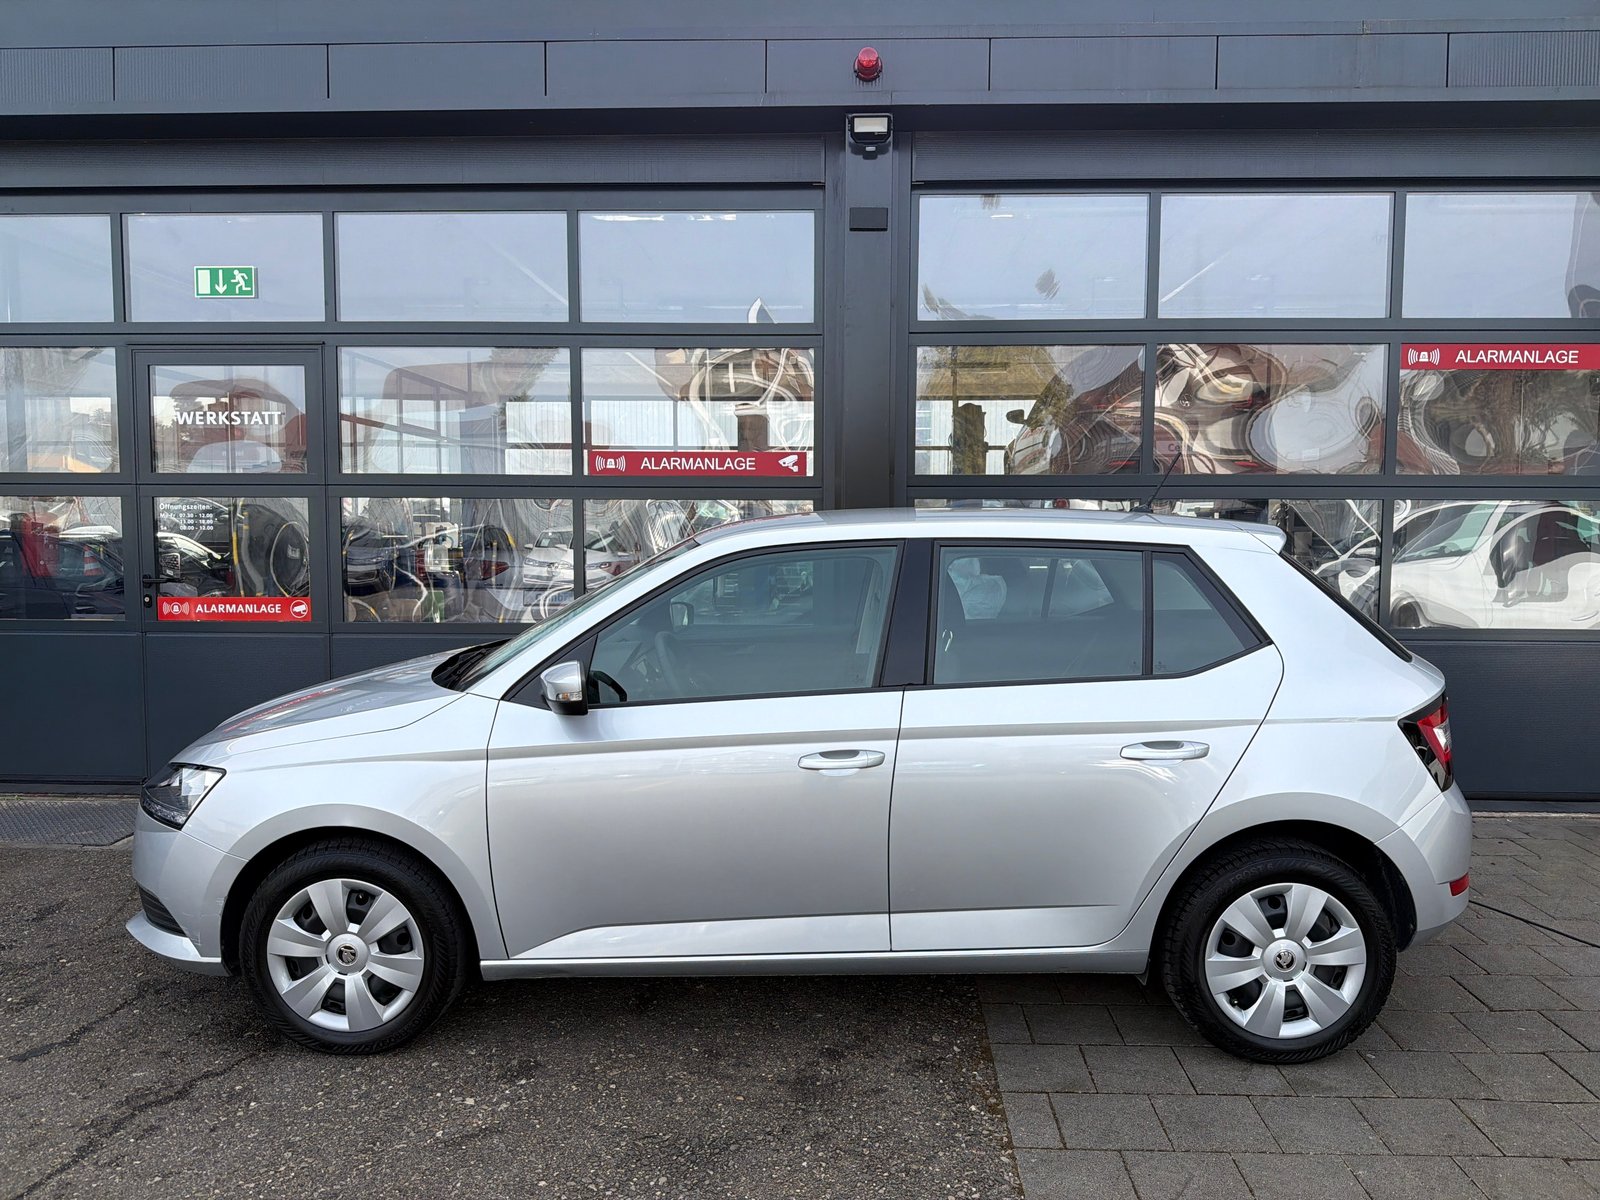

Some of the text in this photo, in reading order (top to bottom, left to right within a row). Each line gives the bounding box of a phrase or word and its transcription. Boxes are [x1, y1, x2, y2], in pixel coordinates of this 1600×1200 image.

[1455, 350, 1579, 364] ALARMANLAGE
[176, 411, 282, 426] WERKSTATT
[640, 457, 756, 471] ALARMANLAGE
[159, 502, 213, 512] Öffnungszeiten:
[195, 603, 282, 614] ALARMANLAGE
